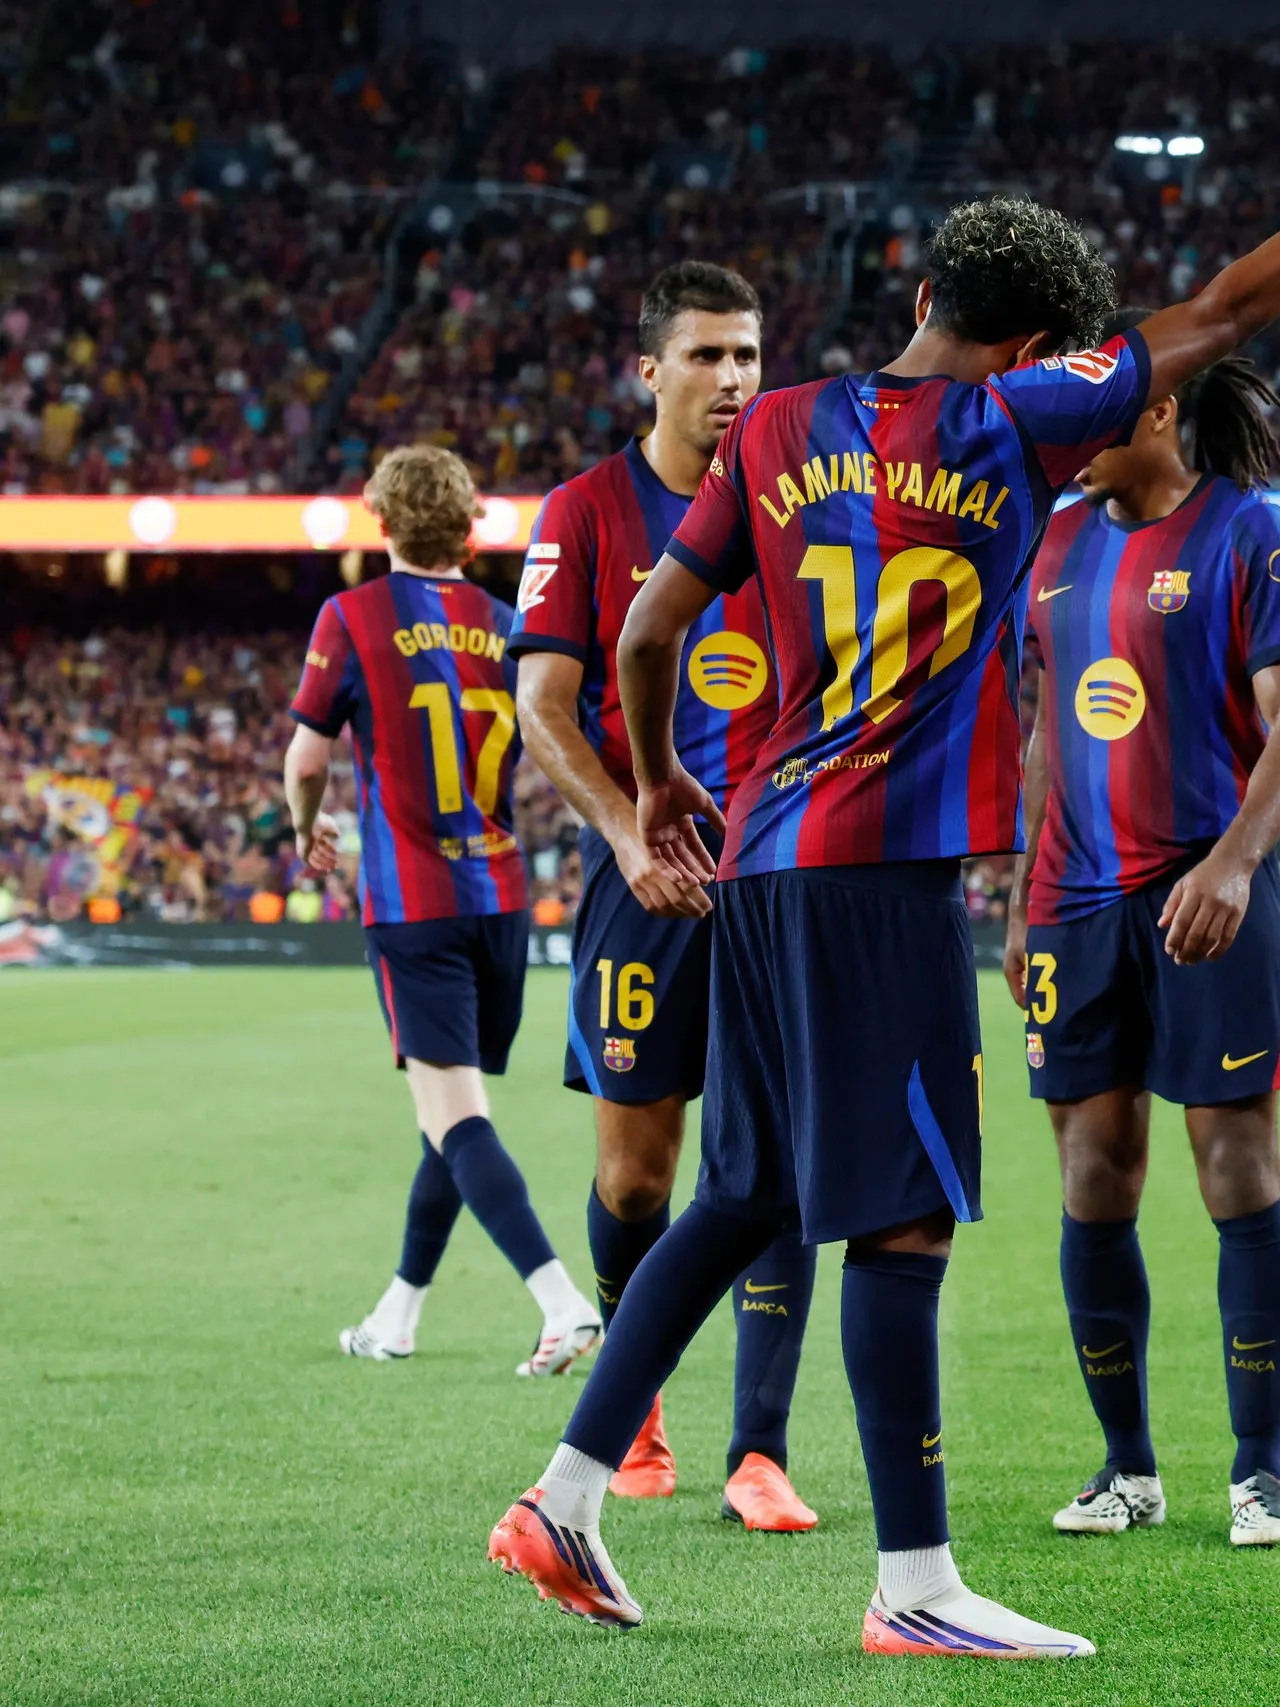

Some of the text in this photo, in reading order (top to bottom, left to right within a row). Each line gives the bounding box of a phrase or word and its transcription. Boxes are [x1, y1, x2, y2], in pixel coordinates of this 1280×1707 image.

[758, 451, 1010, 530] LAMINE YAMAL
[393, 622, 506, 663] GORDON
[796, 545, 982, 732] 10
[409, 682, 516, 816] 17
[596, 958, 655, 1031] 16
[742, 1299, 788, 1316] BARÇA
